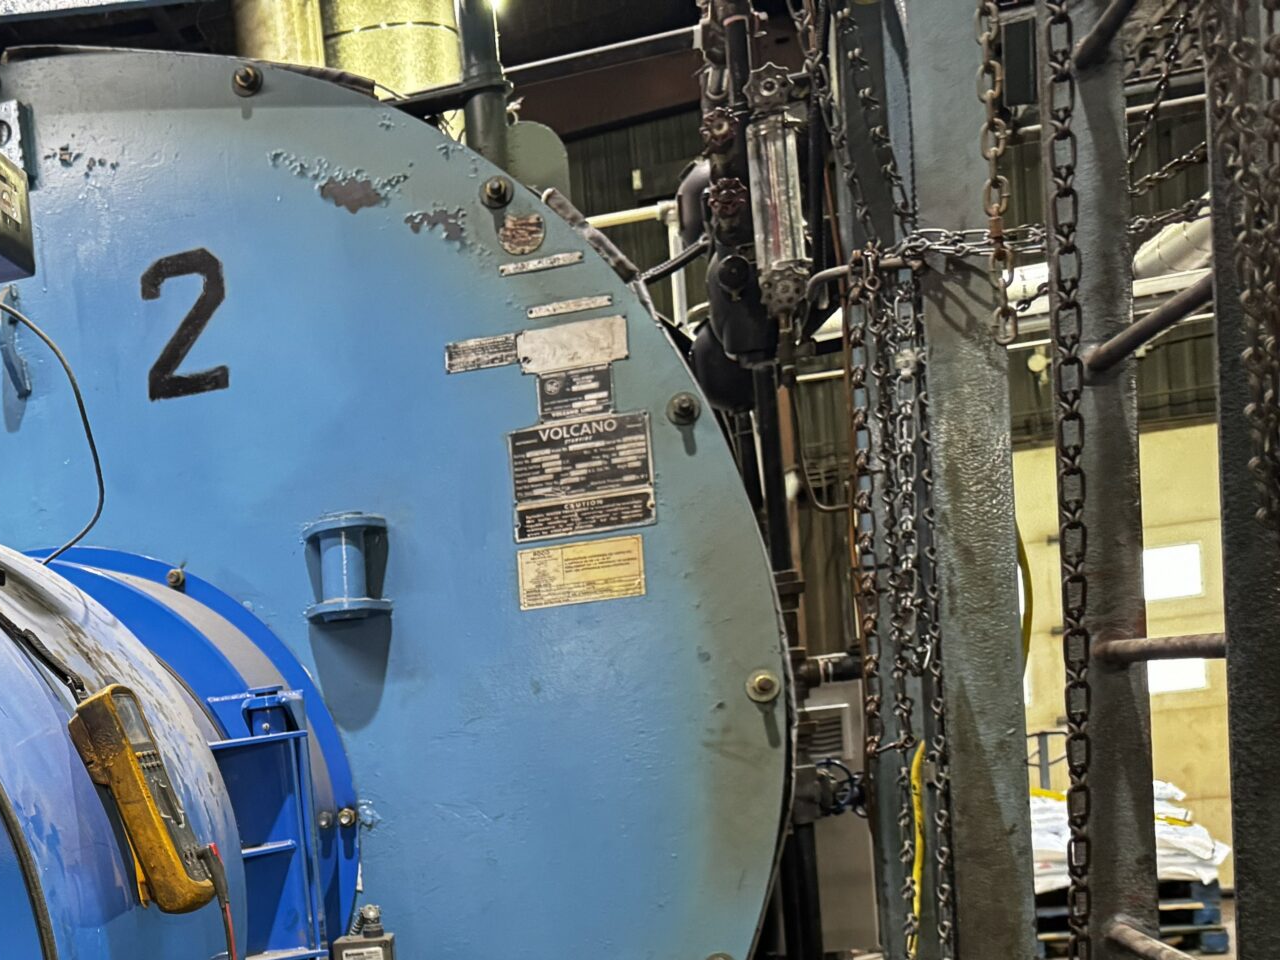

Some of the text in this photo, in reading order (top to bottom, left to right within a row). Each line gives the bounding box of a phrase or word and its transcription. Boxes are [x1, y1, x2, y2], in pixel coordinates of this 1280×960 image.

[141, 247, 229, 402] 2
[538, 419, 617, 442] VOLCANO
[563, 499, 604, 510] CAUTION
